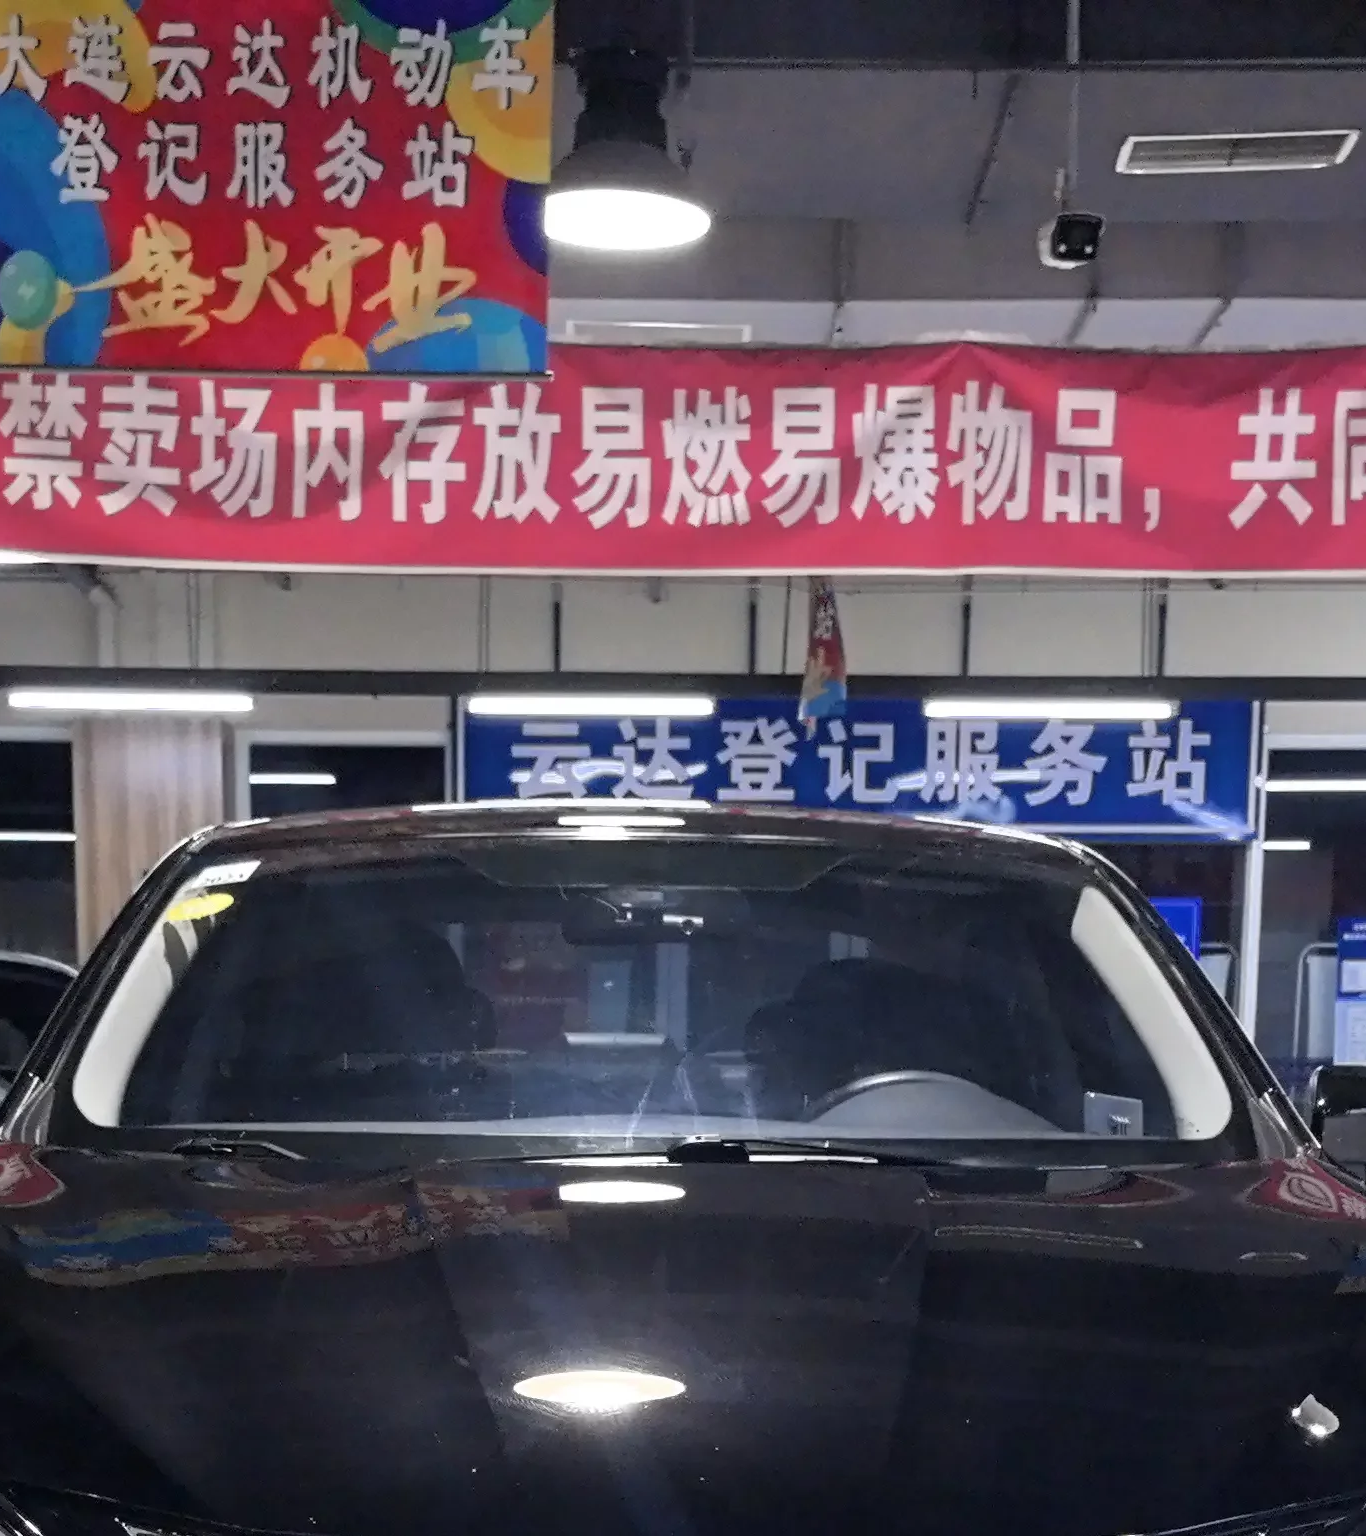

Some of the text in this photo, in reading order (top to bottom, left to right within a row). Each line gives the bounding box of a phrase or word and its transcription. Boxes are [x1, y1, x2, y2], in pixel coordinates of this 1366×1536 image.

[51, 113, 475, 209] 登记服务站
[71, 212, 477, 354] 盛大开业
[510, 716, 1212, 806] 云达登记服务站
